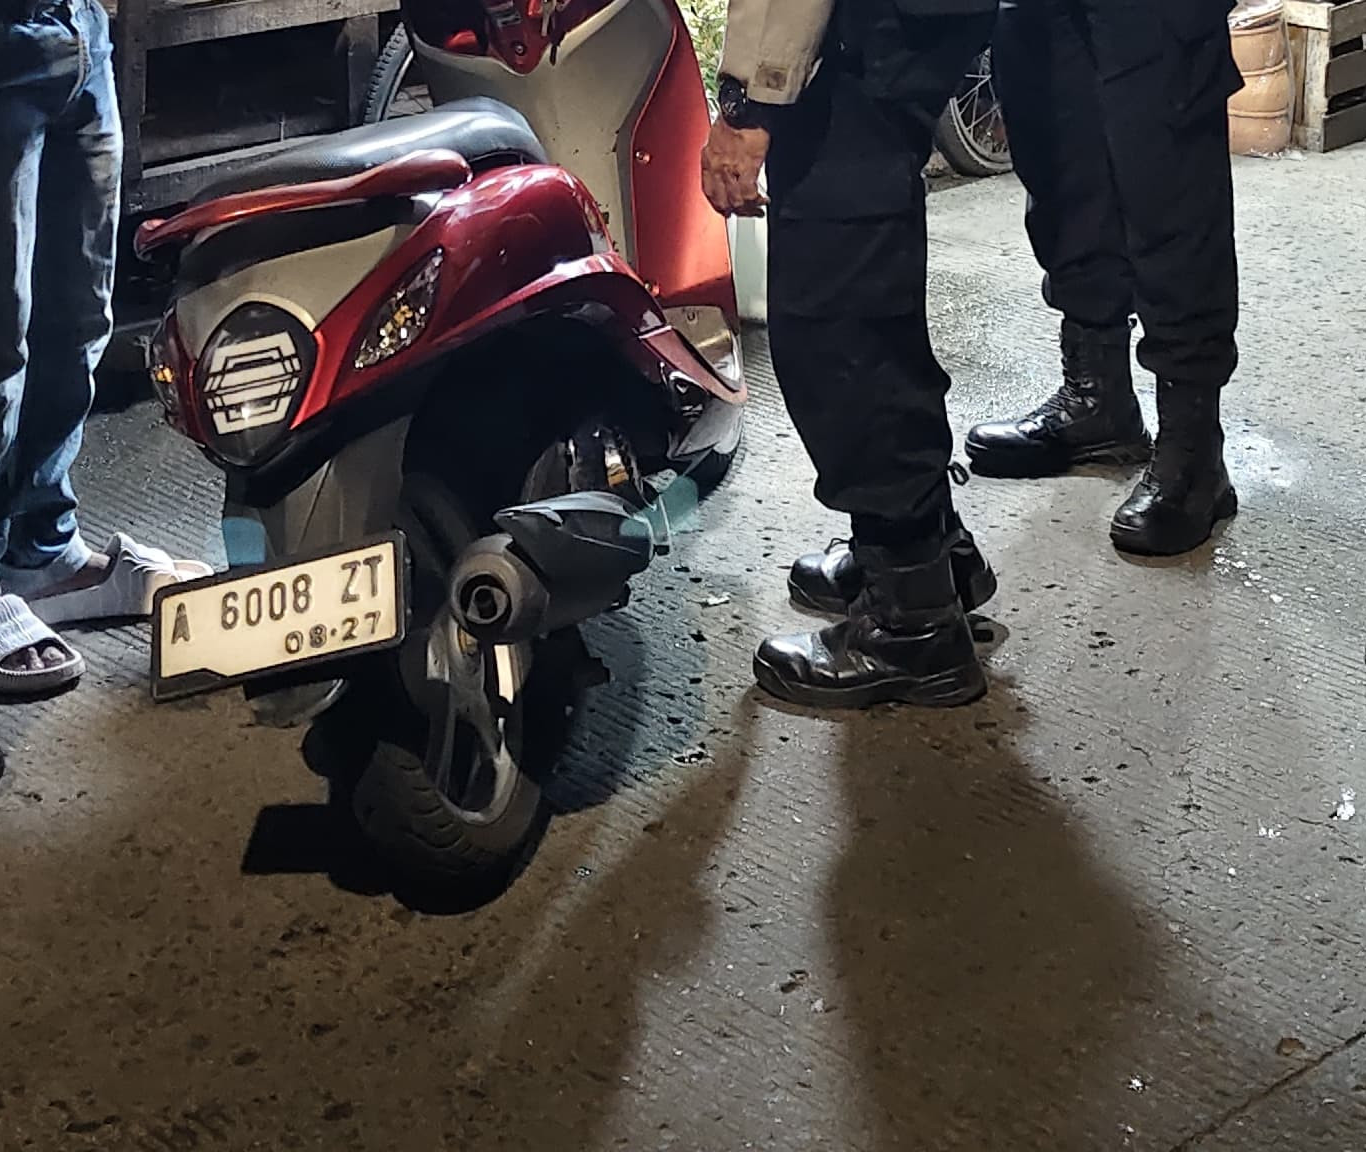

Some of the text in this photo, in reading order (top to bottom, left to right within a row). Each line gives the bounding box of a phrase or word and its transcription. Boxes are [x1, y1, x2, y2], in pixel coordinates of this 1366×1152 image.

[170, 555, 384, 645] A 6008 ZT
